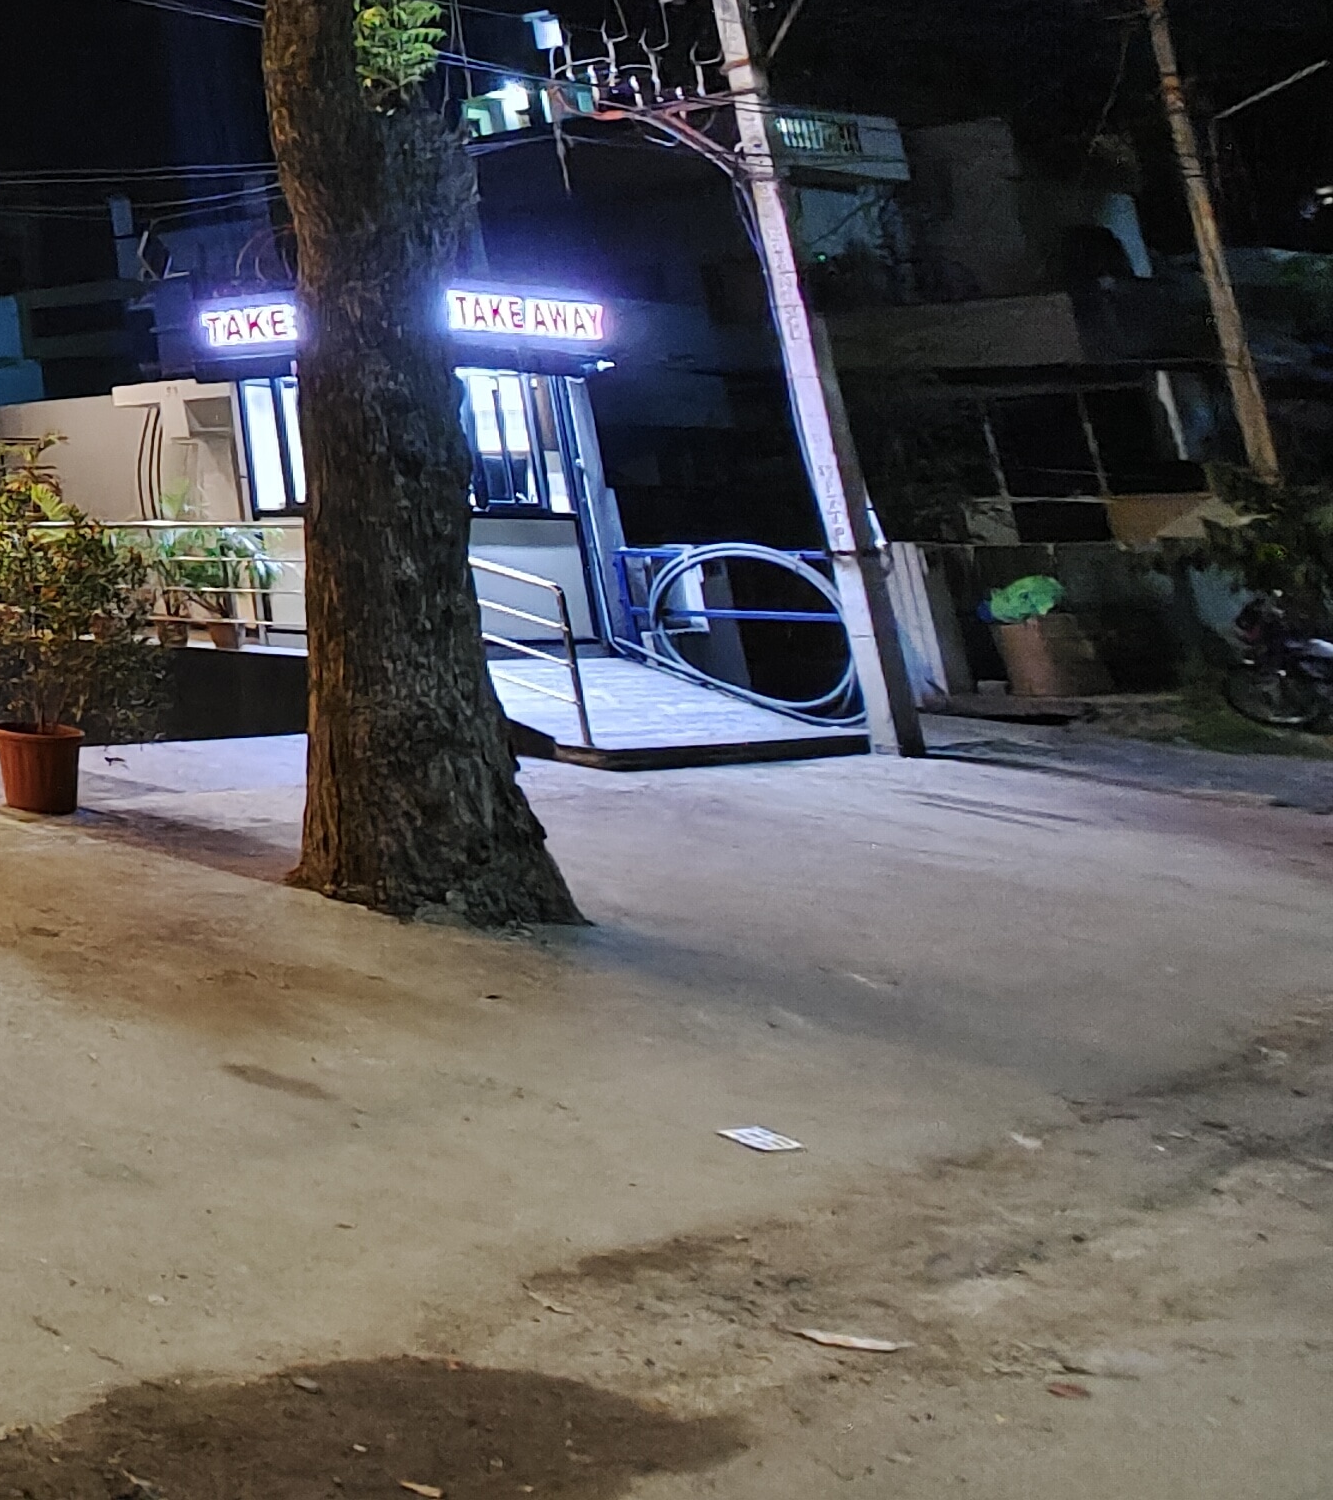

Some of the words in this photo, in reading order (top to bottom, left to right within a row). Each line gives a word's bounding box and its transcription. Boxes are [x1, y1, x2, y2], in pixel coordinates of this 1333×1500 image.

[205, 308, 289, 342] TAKE
[454, 295, 525, 330] TAKE
[533, 302, 599, 338] AWAY
